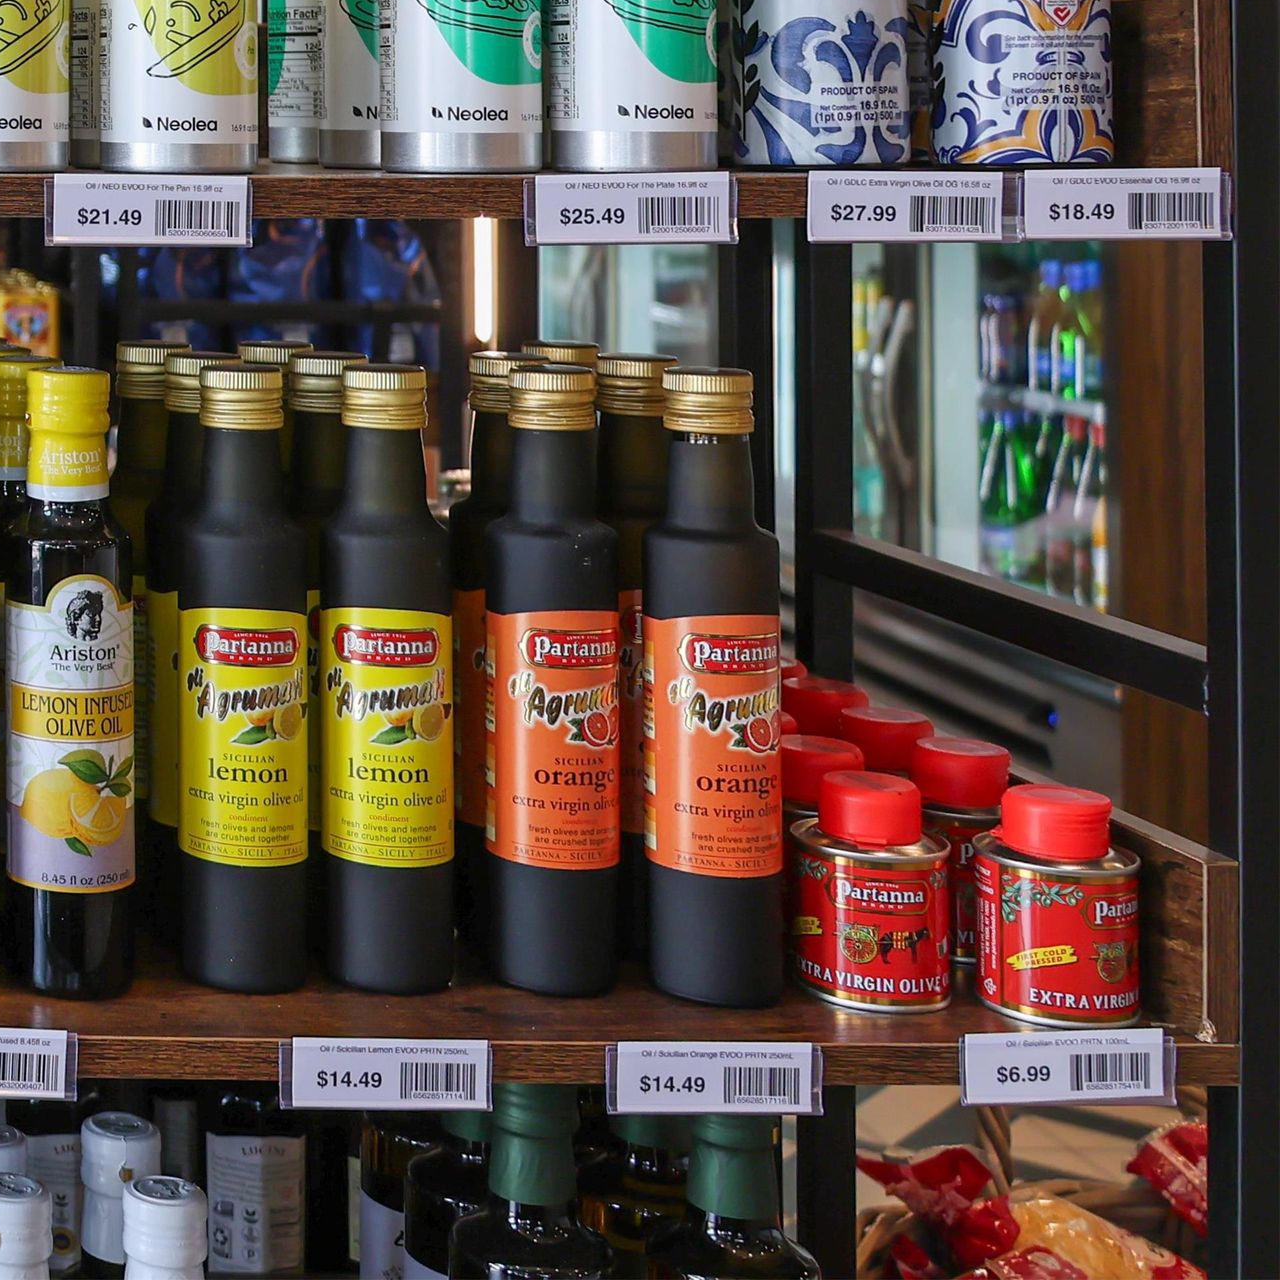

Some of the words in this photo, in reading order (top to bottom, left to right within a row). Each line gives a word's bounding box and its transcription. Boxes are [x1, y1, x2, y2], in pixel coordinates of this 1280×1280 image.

[447, 106, 508, 122] Neolea
[157, 116, 218, 132] Neolea
[78, 208, 141, 226] $21.49
[560, 208, 625, 226] $25.49
[831, 204, 896, 222] $27.99
[1049, 204, 1114, 221] $18.49
[205, 631, 293, 657] Partanna
[208, 757, 288, 784] lemon
[534, 769, 614, 792] orange
[188, 787, 215, 802] extra
[218, 791, 258, 809] virgin
[263, 792, 292, 805] olive
[836, 879, 924, 904] Partanna
[1016, 951, 1039, 962] FIRST
[1043, 948, 1067, 958] COLD
[1024, 955, 1063, 965] PRESSED
[836, 971, 894, 993] VIRGIN
[900, 978, 941, 993] OLIVE
[1029, 988, 1090, 1010] EXTRA
[317, 1071, 382, 1089] $14.49
[996, 1066, 1051, 1084] $6.99
[640, 1076, 705, 1094] $14.49
